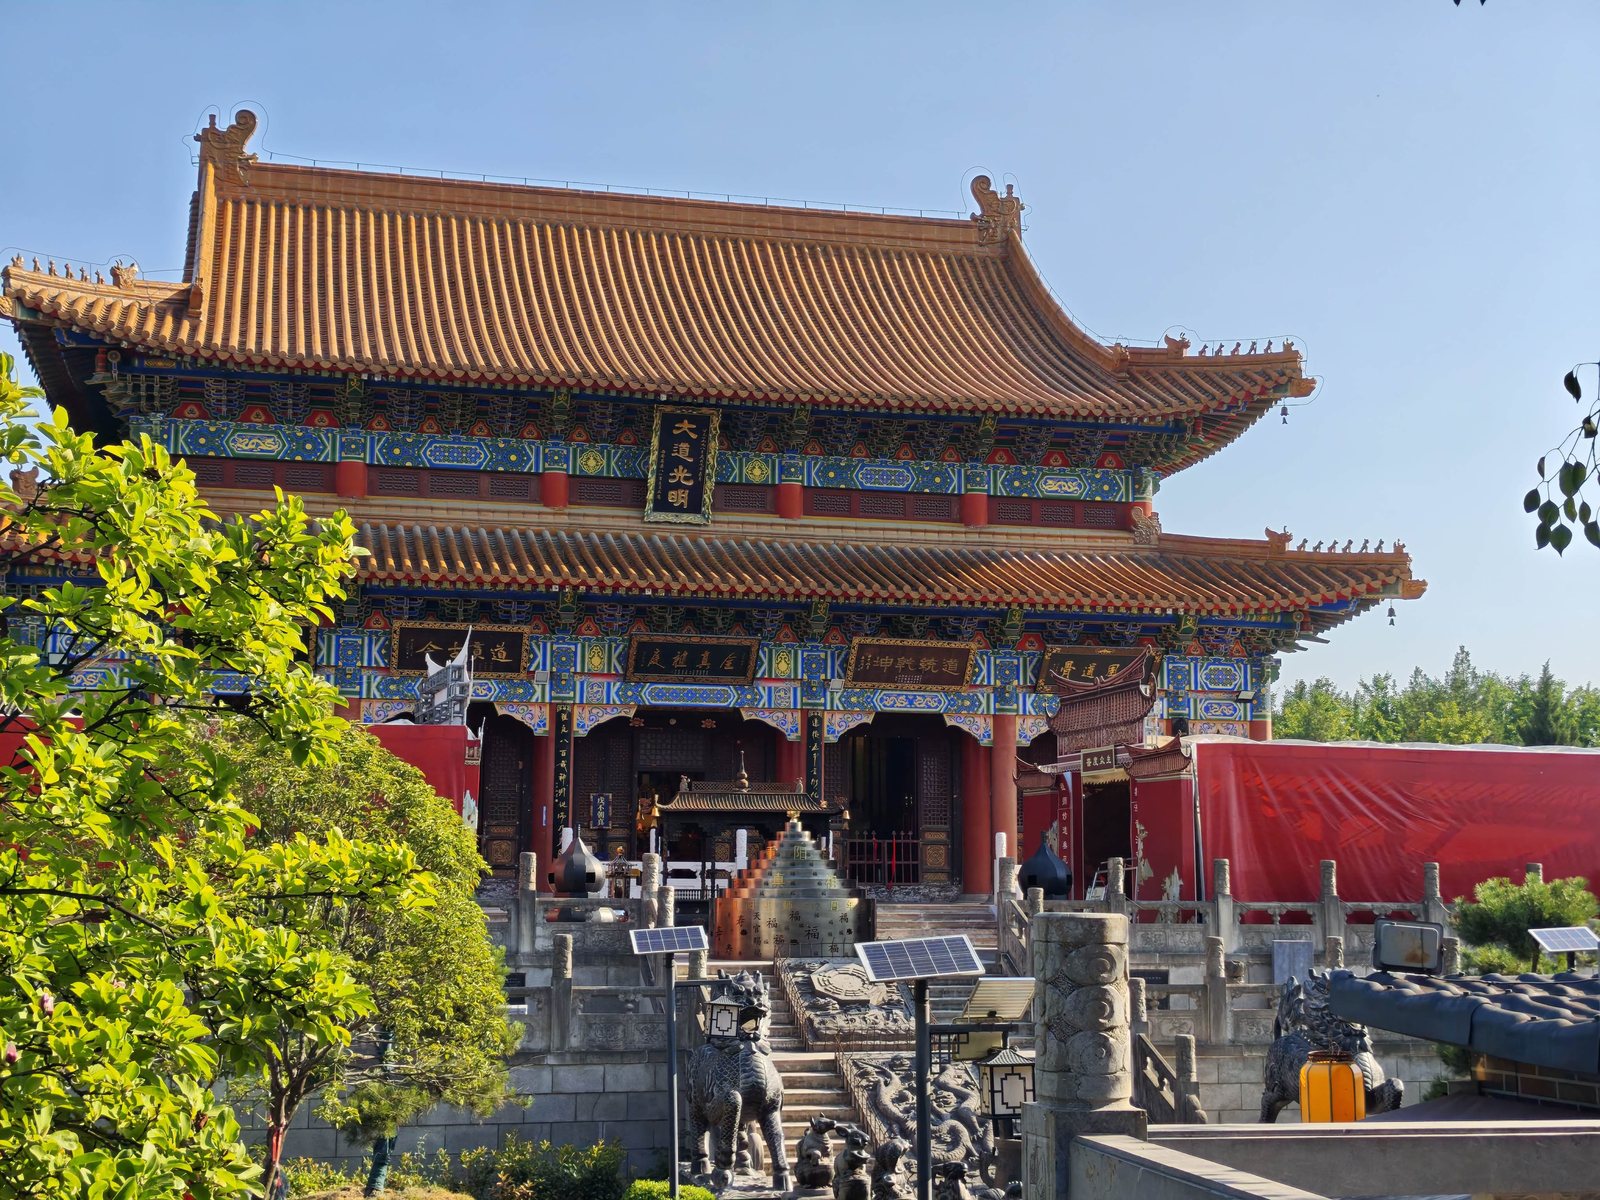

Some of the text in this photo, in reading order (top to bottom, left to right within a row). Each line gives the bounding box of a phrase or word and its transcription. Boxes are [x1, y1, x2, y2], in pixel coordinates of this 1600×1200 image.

[668, 419, 698, 508] 大道光明
[766, 918, 778, 928] 福
[804, 925, 819, 939] 福
